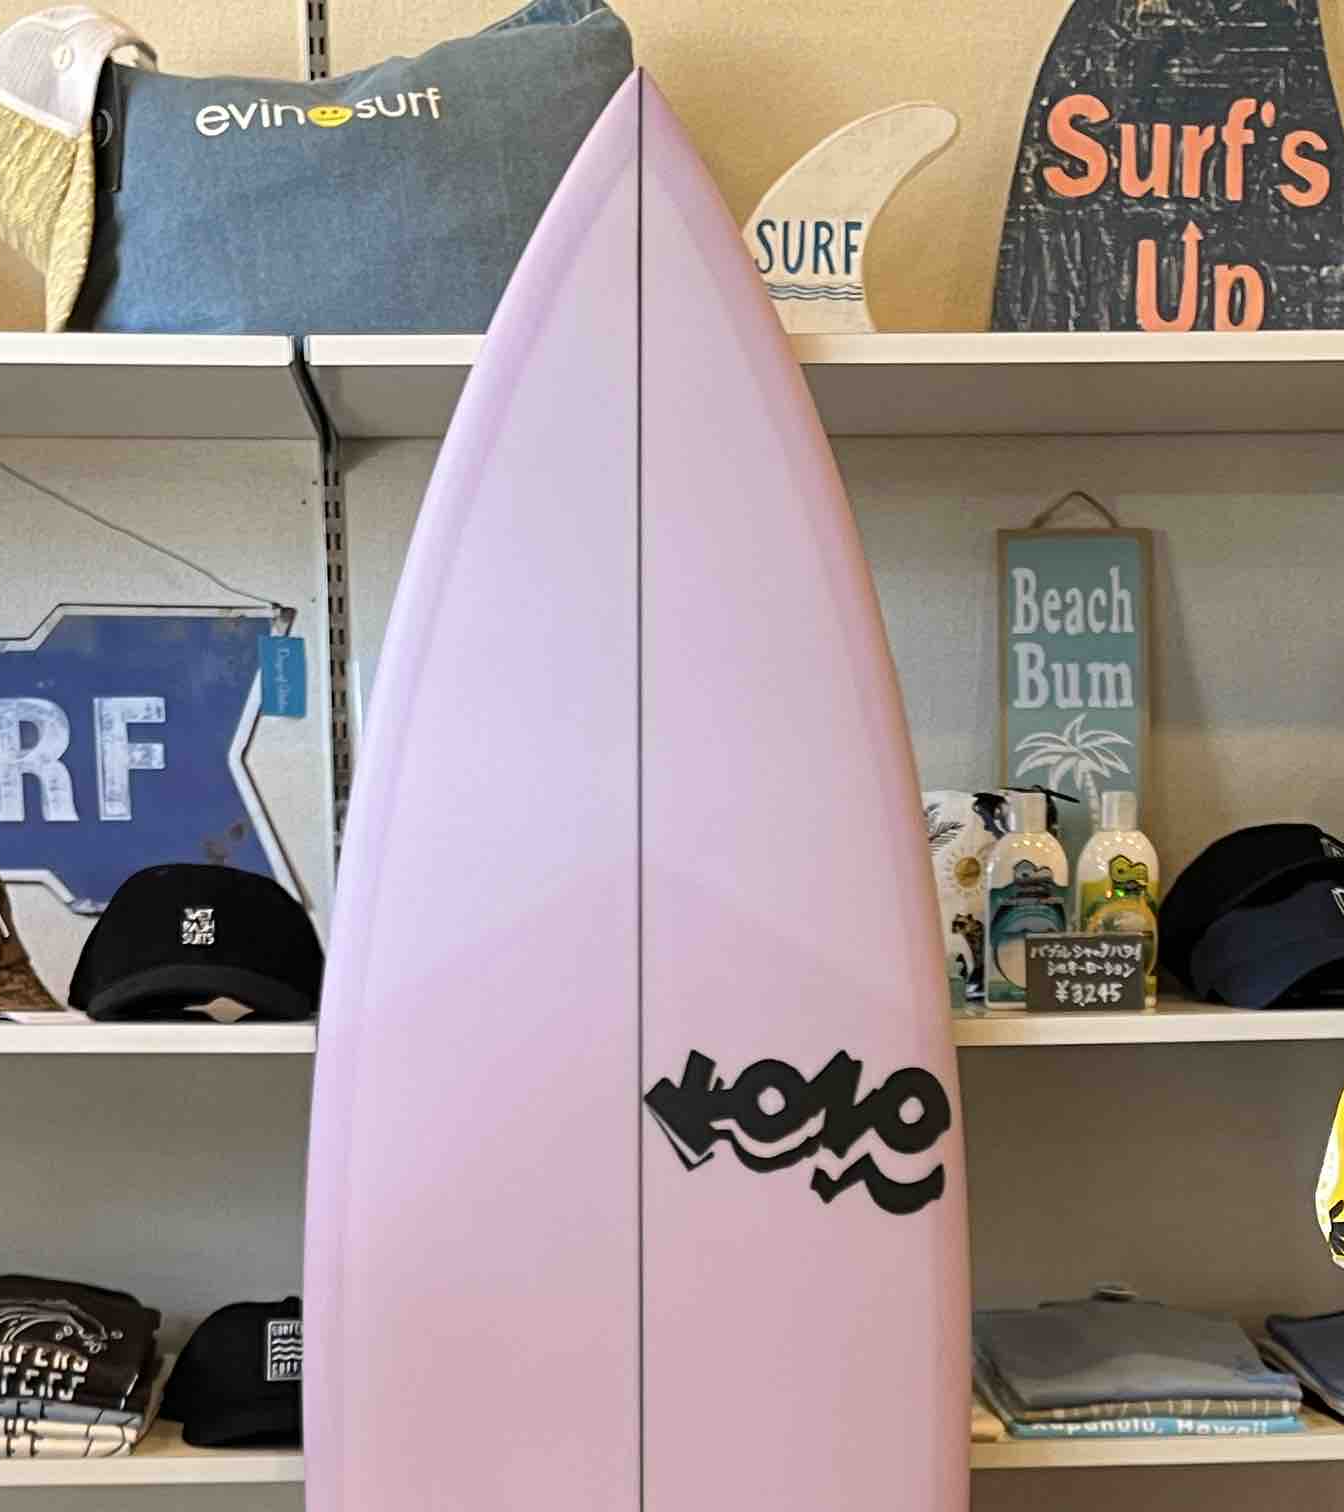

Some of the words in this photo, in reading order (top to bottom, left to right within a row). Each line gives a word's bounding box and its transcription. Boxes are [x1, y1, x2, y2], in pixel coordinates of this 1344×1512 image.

[1042, 93, 1331, 207] Surf's
[754, 218, 865, 277] SURF
[1135, 221, 1266, 331] Up
[1010, 565, 1135, 635] Beach
[1011, 641, 1135, 709] Bum
